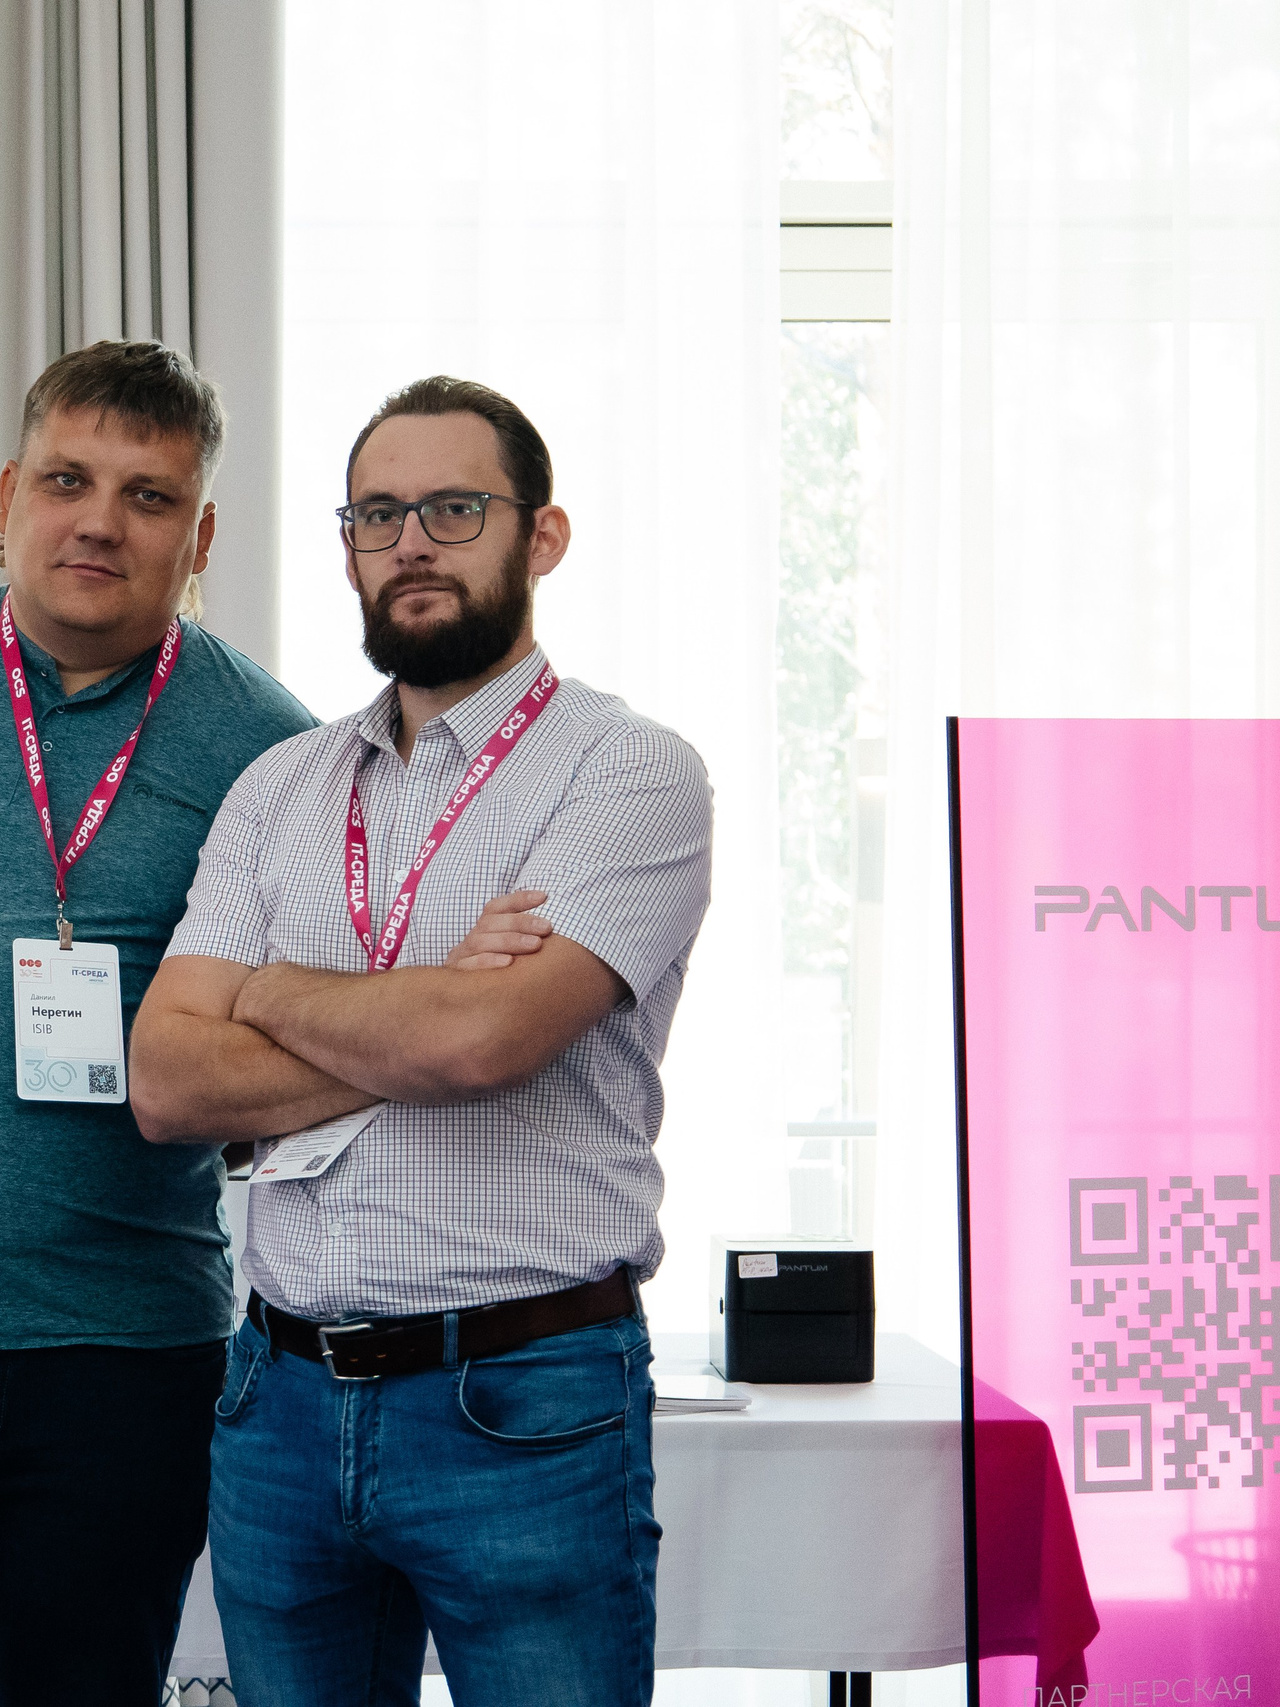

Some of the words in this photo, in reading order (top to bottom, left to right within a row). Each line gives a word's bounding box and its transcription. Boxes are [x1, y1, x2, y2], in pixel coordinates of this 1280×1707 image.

[12, 667, 26, 698] OCS
[500, 709, 527, 740] OCS
[22, 717, 42, 787] IT-СРЕДА
[106, 754, 127, 783] OCS
[440, 753, 496, 823] IT-СРЕДА
[42, 807, 51, 839] OCS
[352, 798, 362, 828] OCS
[65, 798, 107, 864] IT-СРЕДА
[414, 838, 436, 872] OCS
[350, 842, 365, 914] IT-СРЕДА
[32, 1006, 82, 1019] Неретин
[32, 1024, 53, 1034] ISIB
[24, 1059, 78, 1093] 30
[778, 1264, 828, 1272] PANTUM
[1023, 1674, 1251, 1707] ПАРТНЕРСКАЯ
